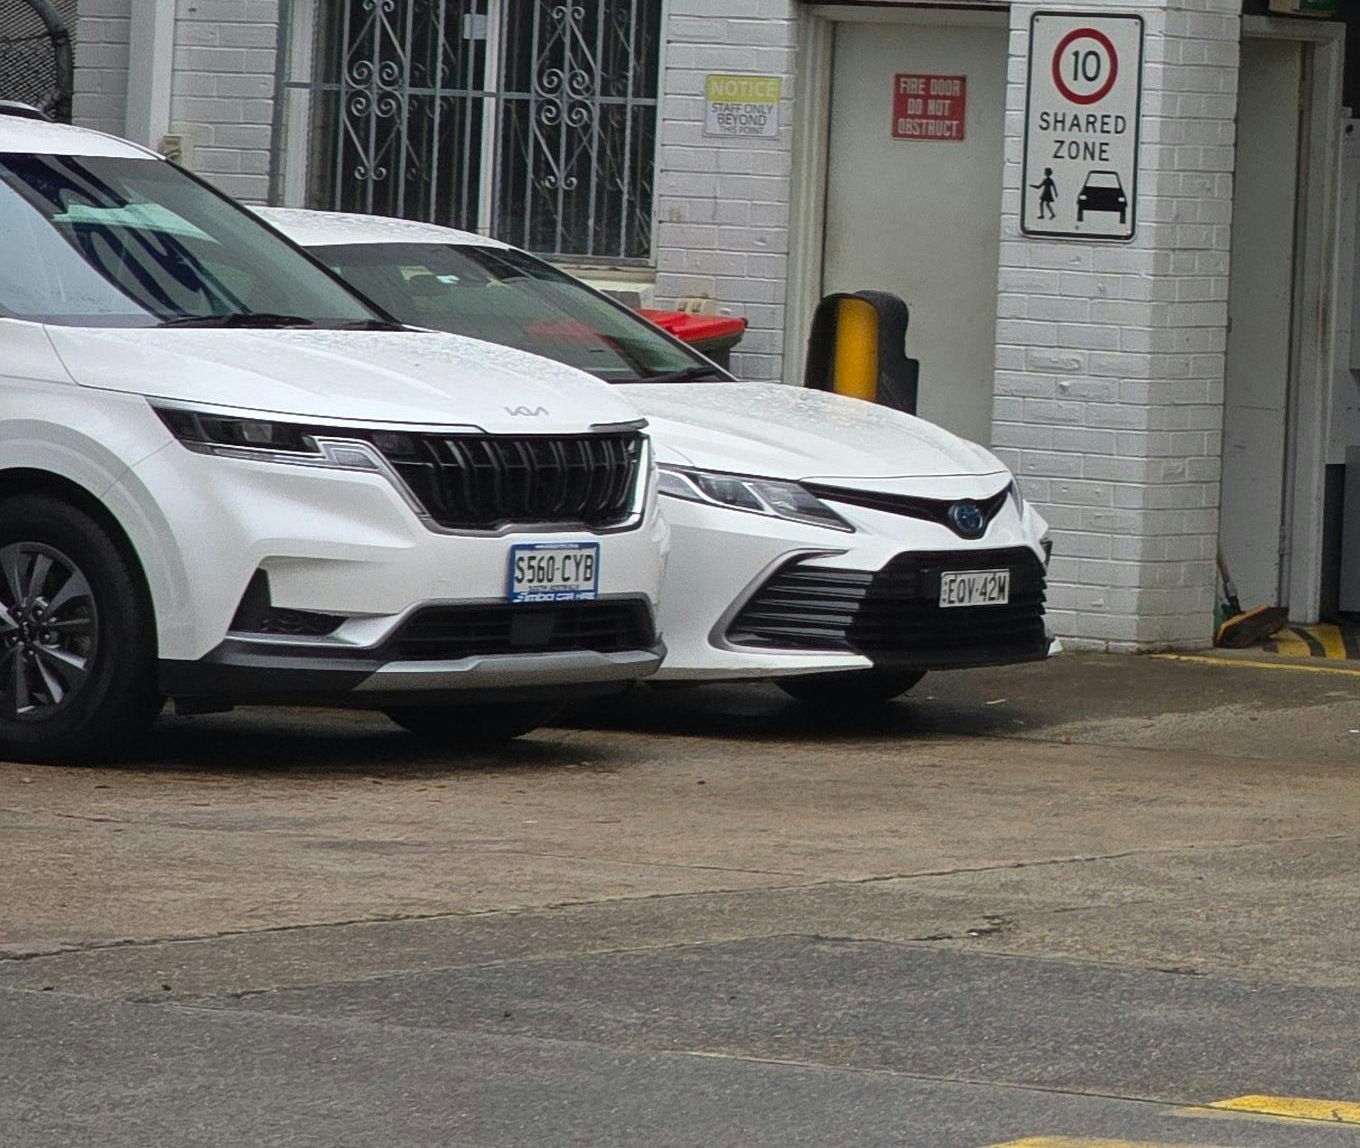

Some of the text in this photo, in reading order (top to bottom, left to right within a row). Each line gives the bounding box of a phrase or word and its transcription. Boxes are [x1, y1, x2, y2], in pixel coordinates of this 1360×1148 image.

[1072, 50, 1101, 82] 10
[711, 80, 777, 99] NOTICE
[900, 78, 961, 97] FIRE DOOR
[711, 103, 774, 115] STAFF ONLY
[907, 98, 951, 116] DO NOT
[717, 113, 767, 126] BEYOND
[898, 118, 960, 137] OBSTRUCT
[1039, 111, 1127, 134] SHARED
[1052, 140, 1110, 162] ZONE
[514, 554, 594, 583] S560-CYB
